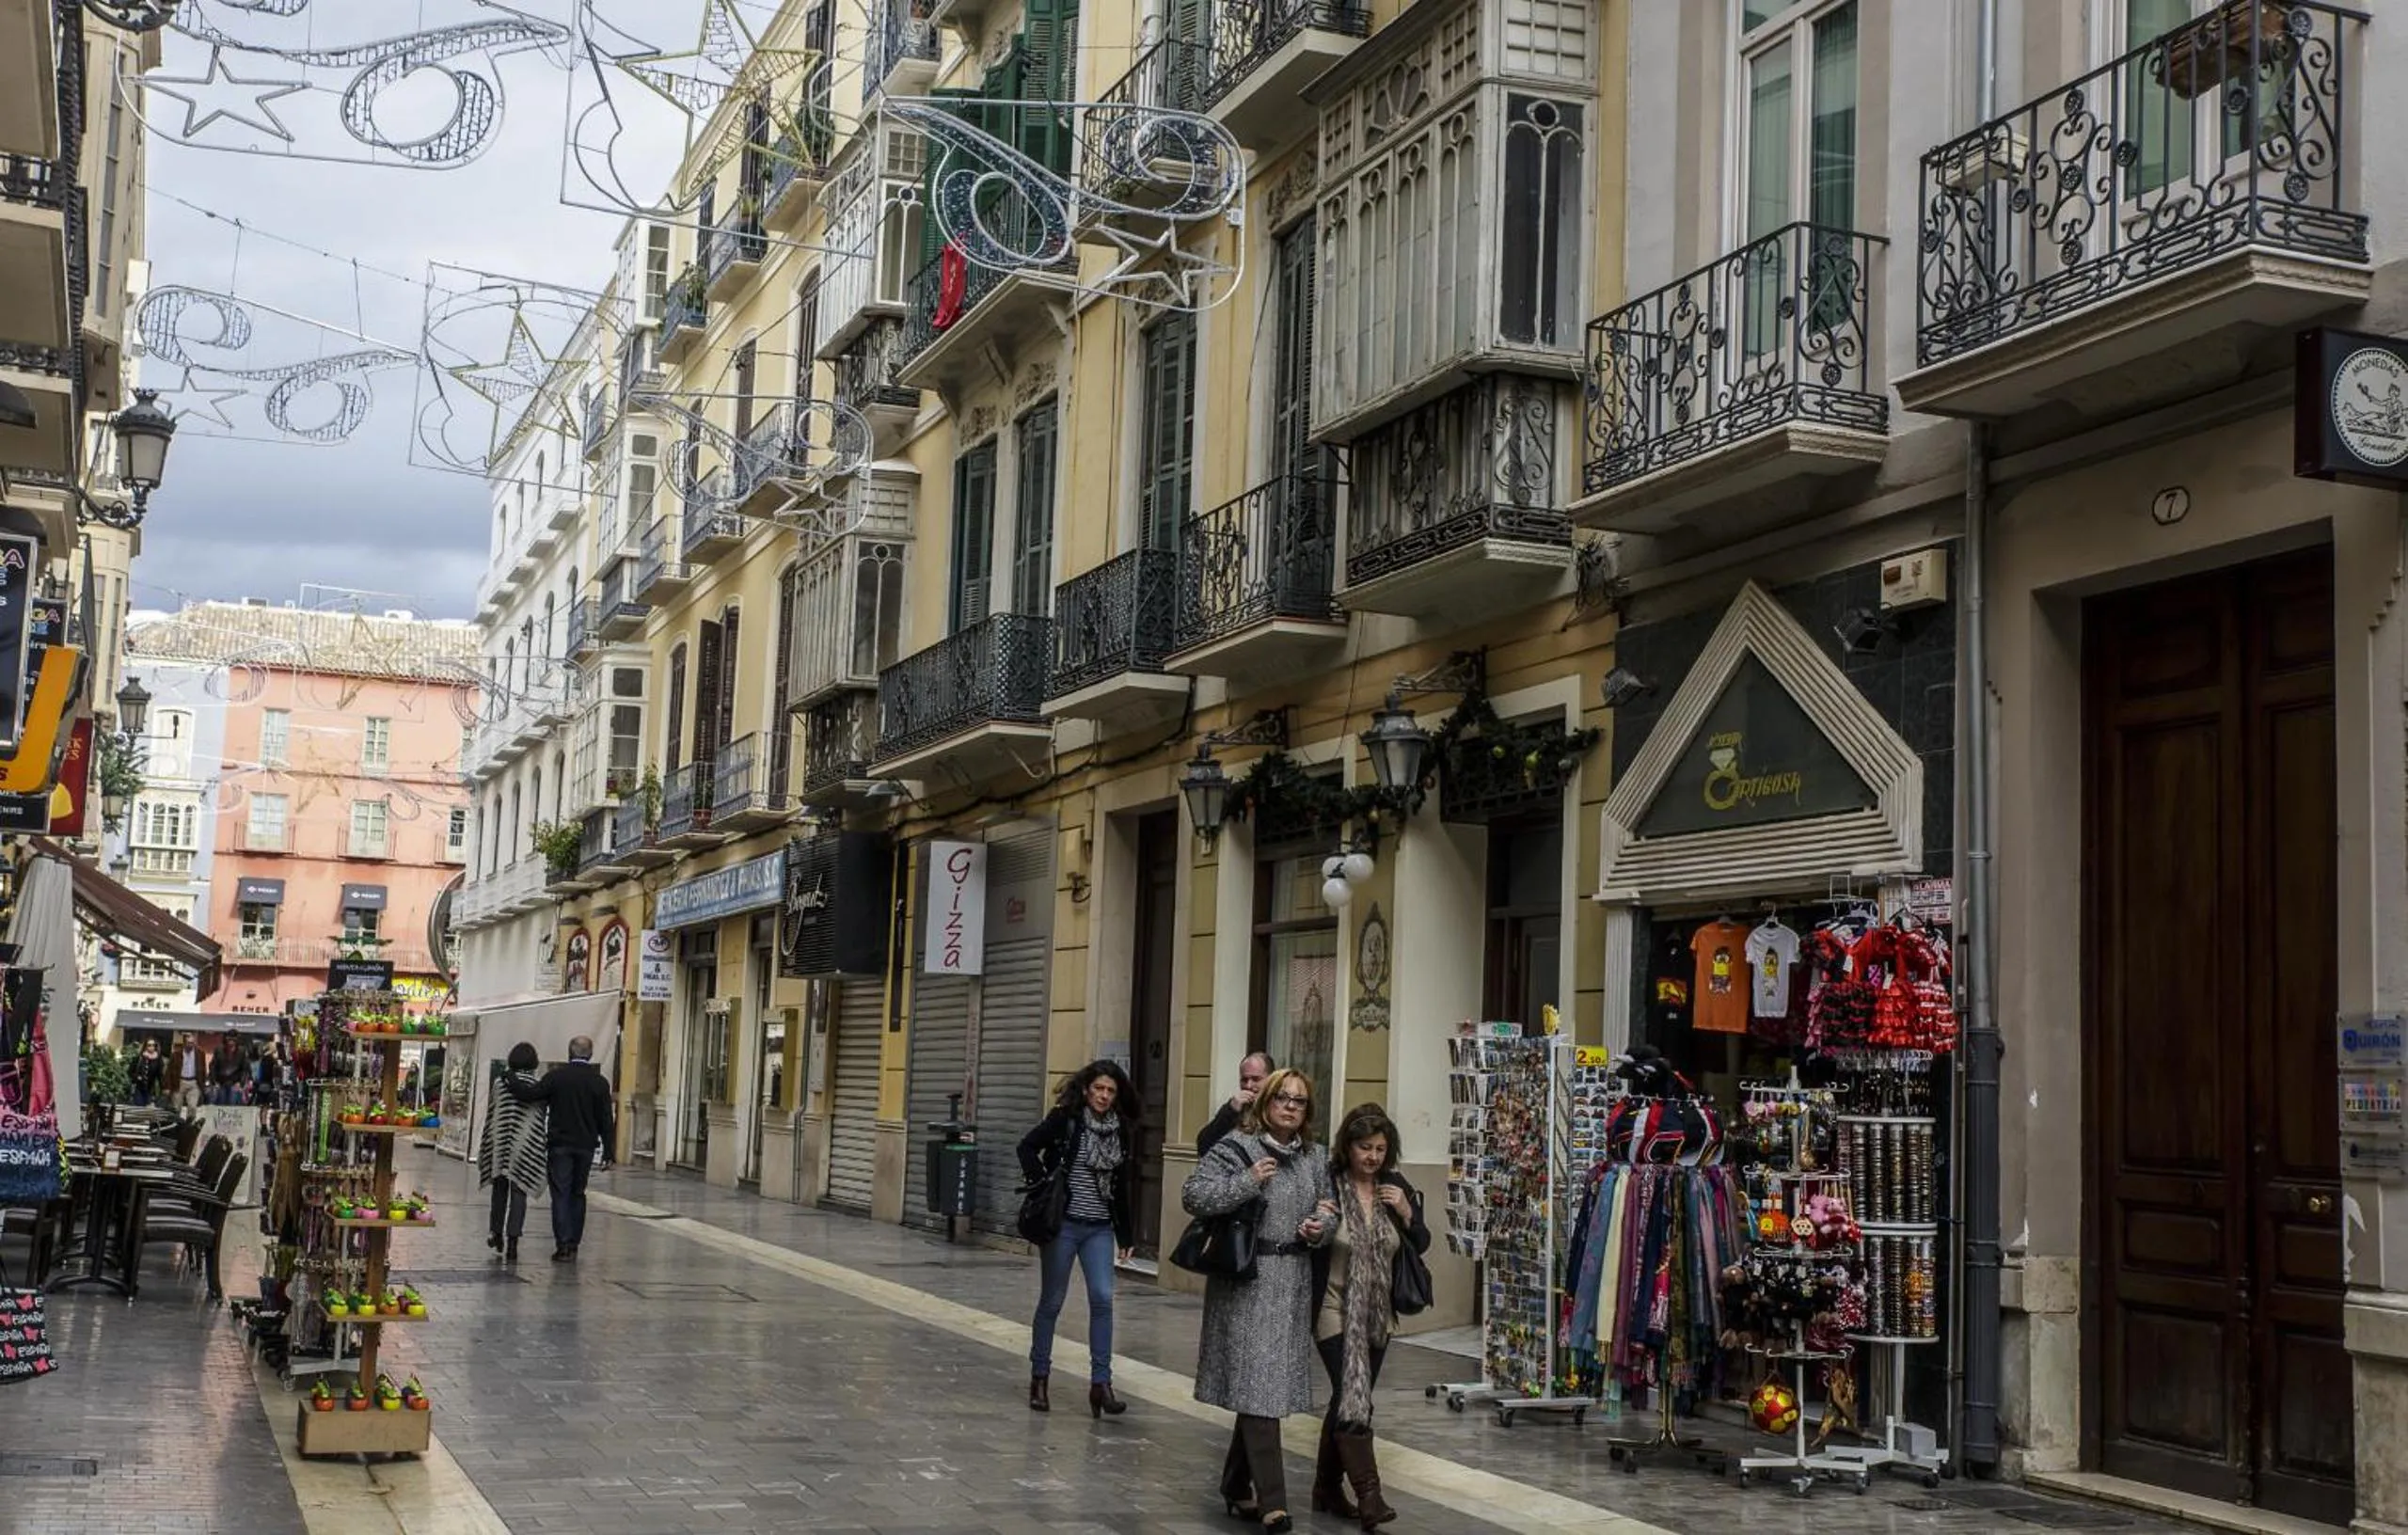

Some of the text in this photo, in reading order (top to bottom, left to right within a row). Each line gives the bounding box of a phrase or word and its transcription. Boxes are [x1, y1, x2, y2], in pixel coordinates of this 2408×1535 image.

[2353, 357, 2400, 378] MONEDAS
[2165, 492, 2178, 519] 7
[943, 847, 973, 969] Gizza
